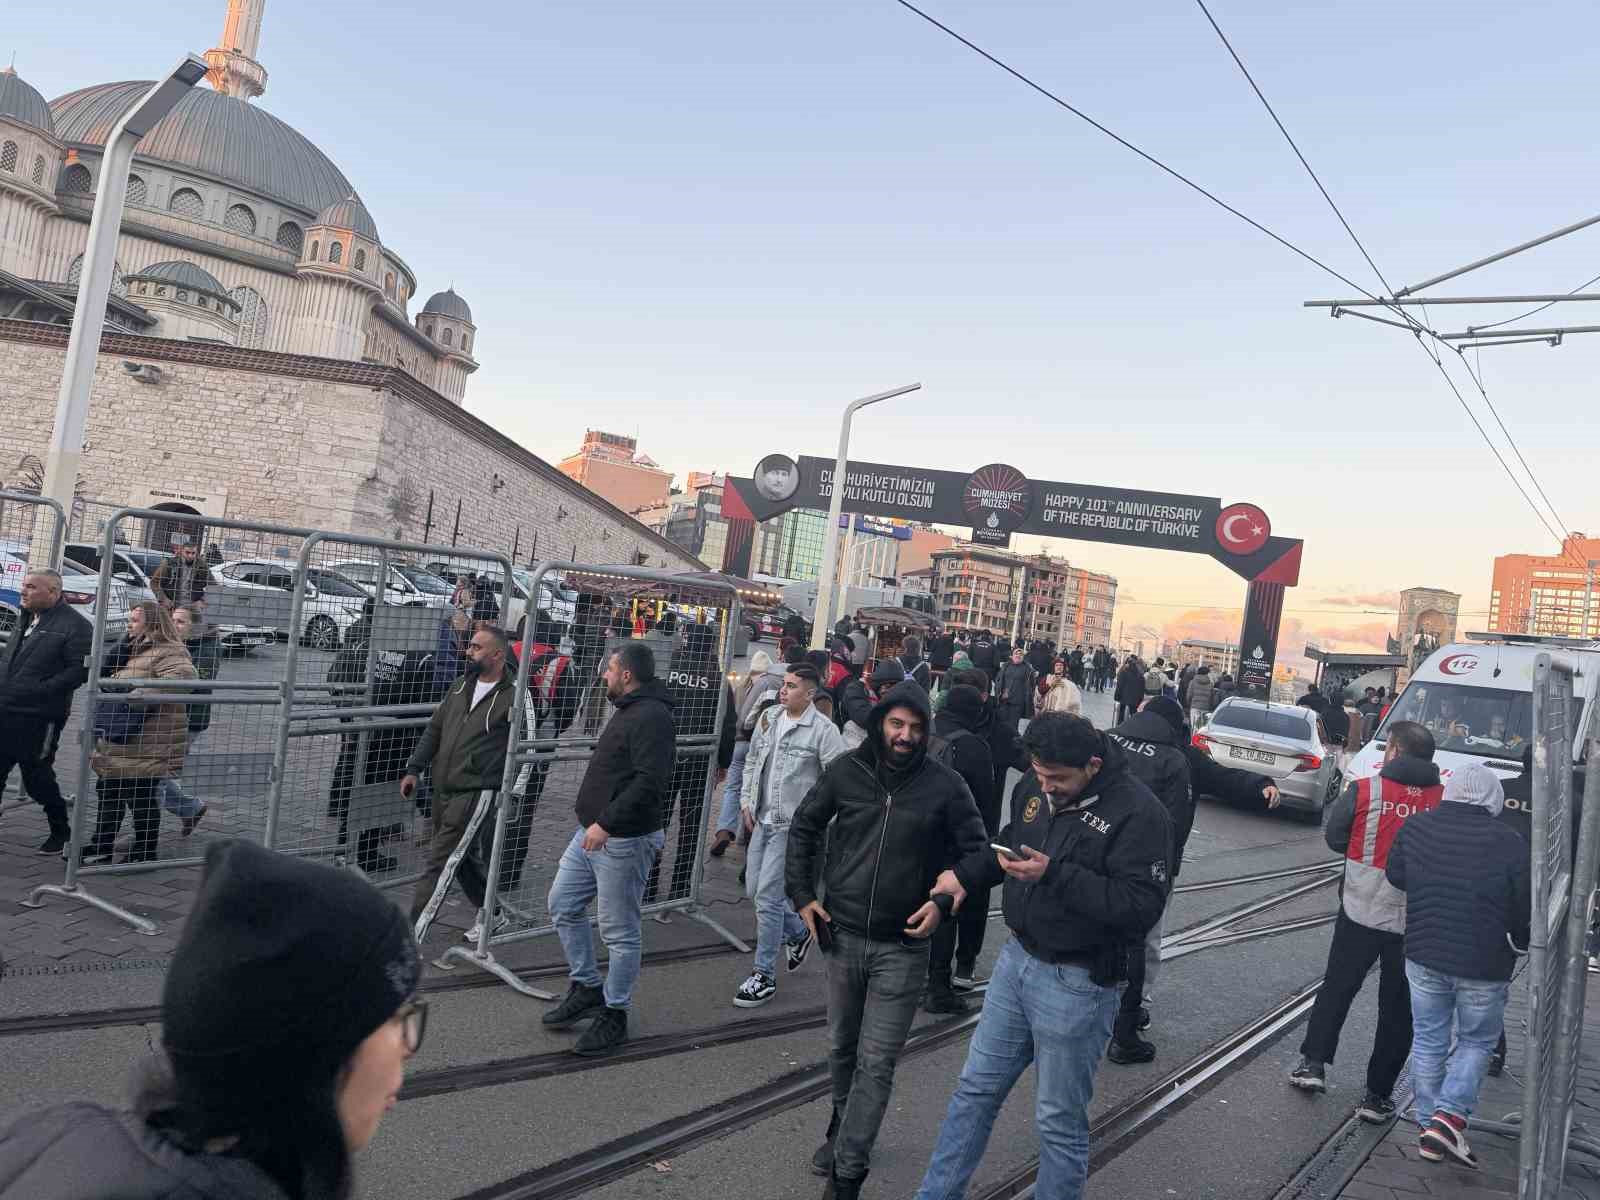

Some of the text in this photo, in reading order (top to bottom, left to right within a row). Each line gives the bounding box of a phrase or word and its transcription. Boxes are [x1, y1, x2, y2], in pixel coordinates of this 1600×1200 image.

[820, 470, 935, 494] CUHURİYETİMİZİN
[862, 488, 896, 504] KUTLU
[897, 492, 933, 508] OLSUN
[1045, 493, 1085, 509] HAPPY
[1115, 501, 1203, 522] ANNIVERSARY
[1043, 509, 1201, 538] OF THE REPUBLIC OF TÜRKİYE
[1452, 659, 1478, 670] 112
[1080, 811, 1111, 834] TEM
